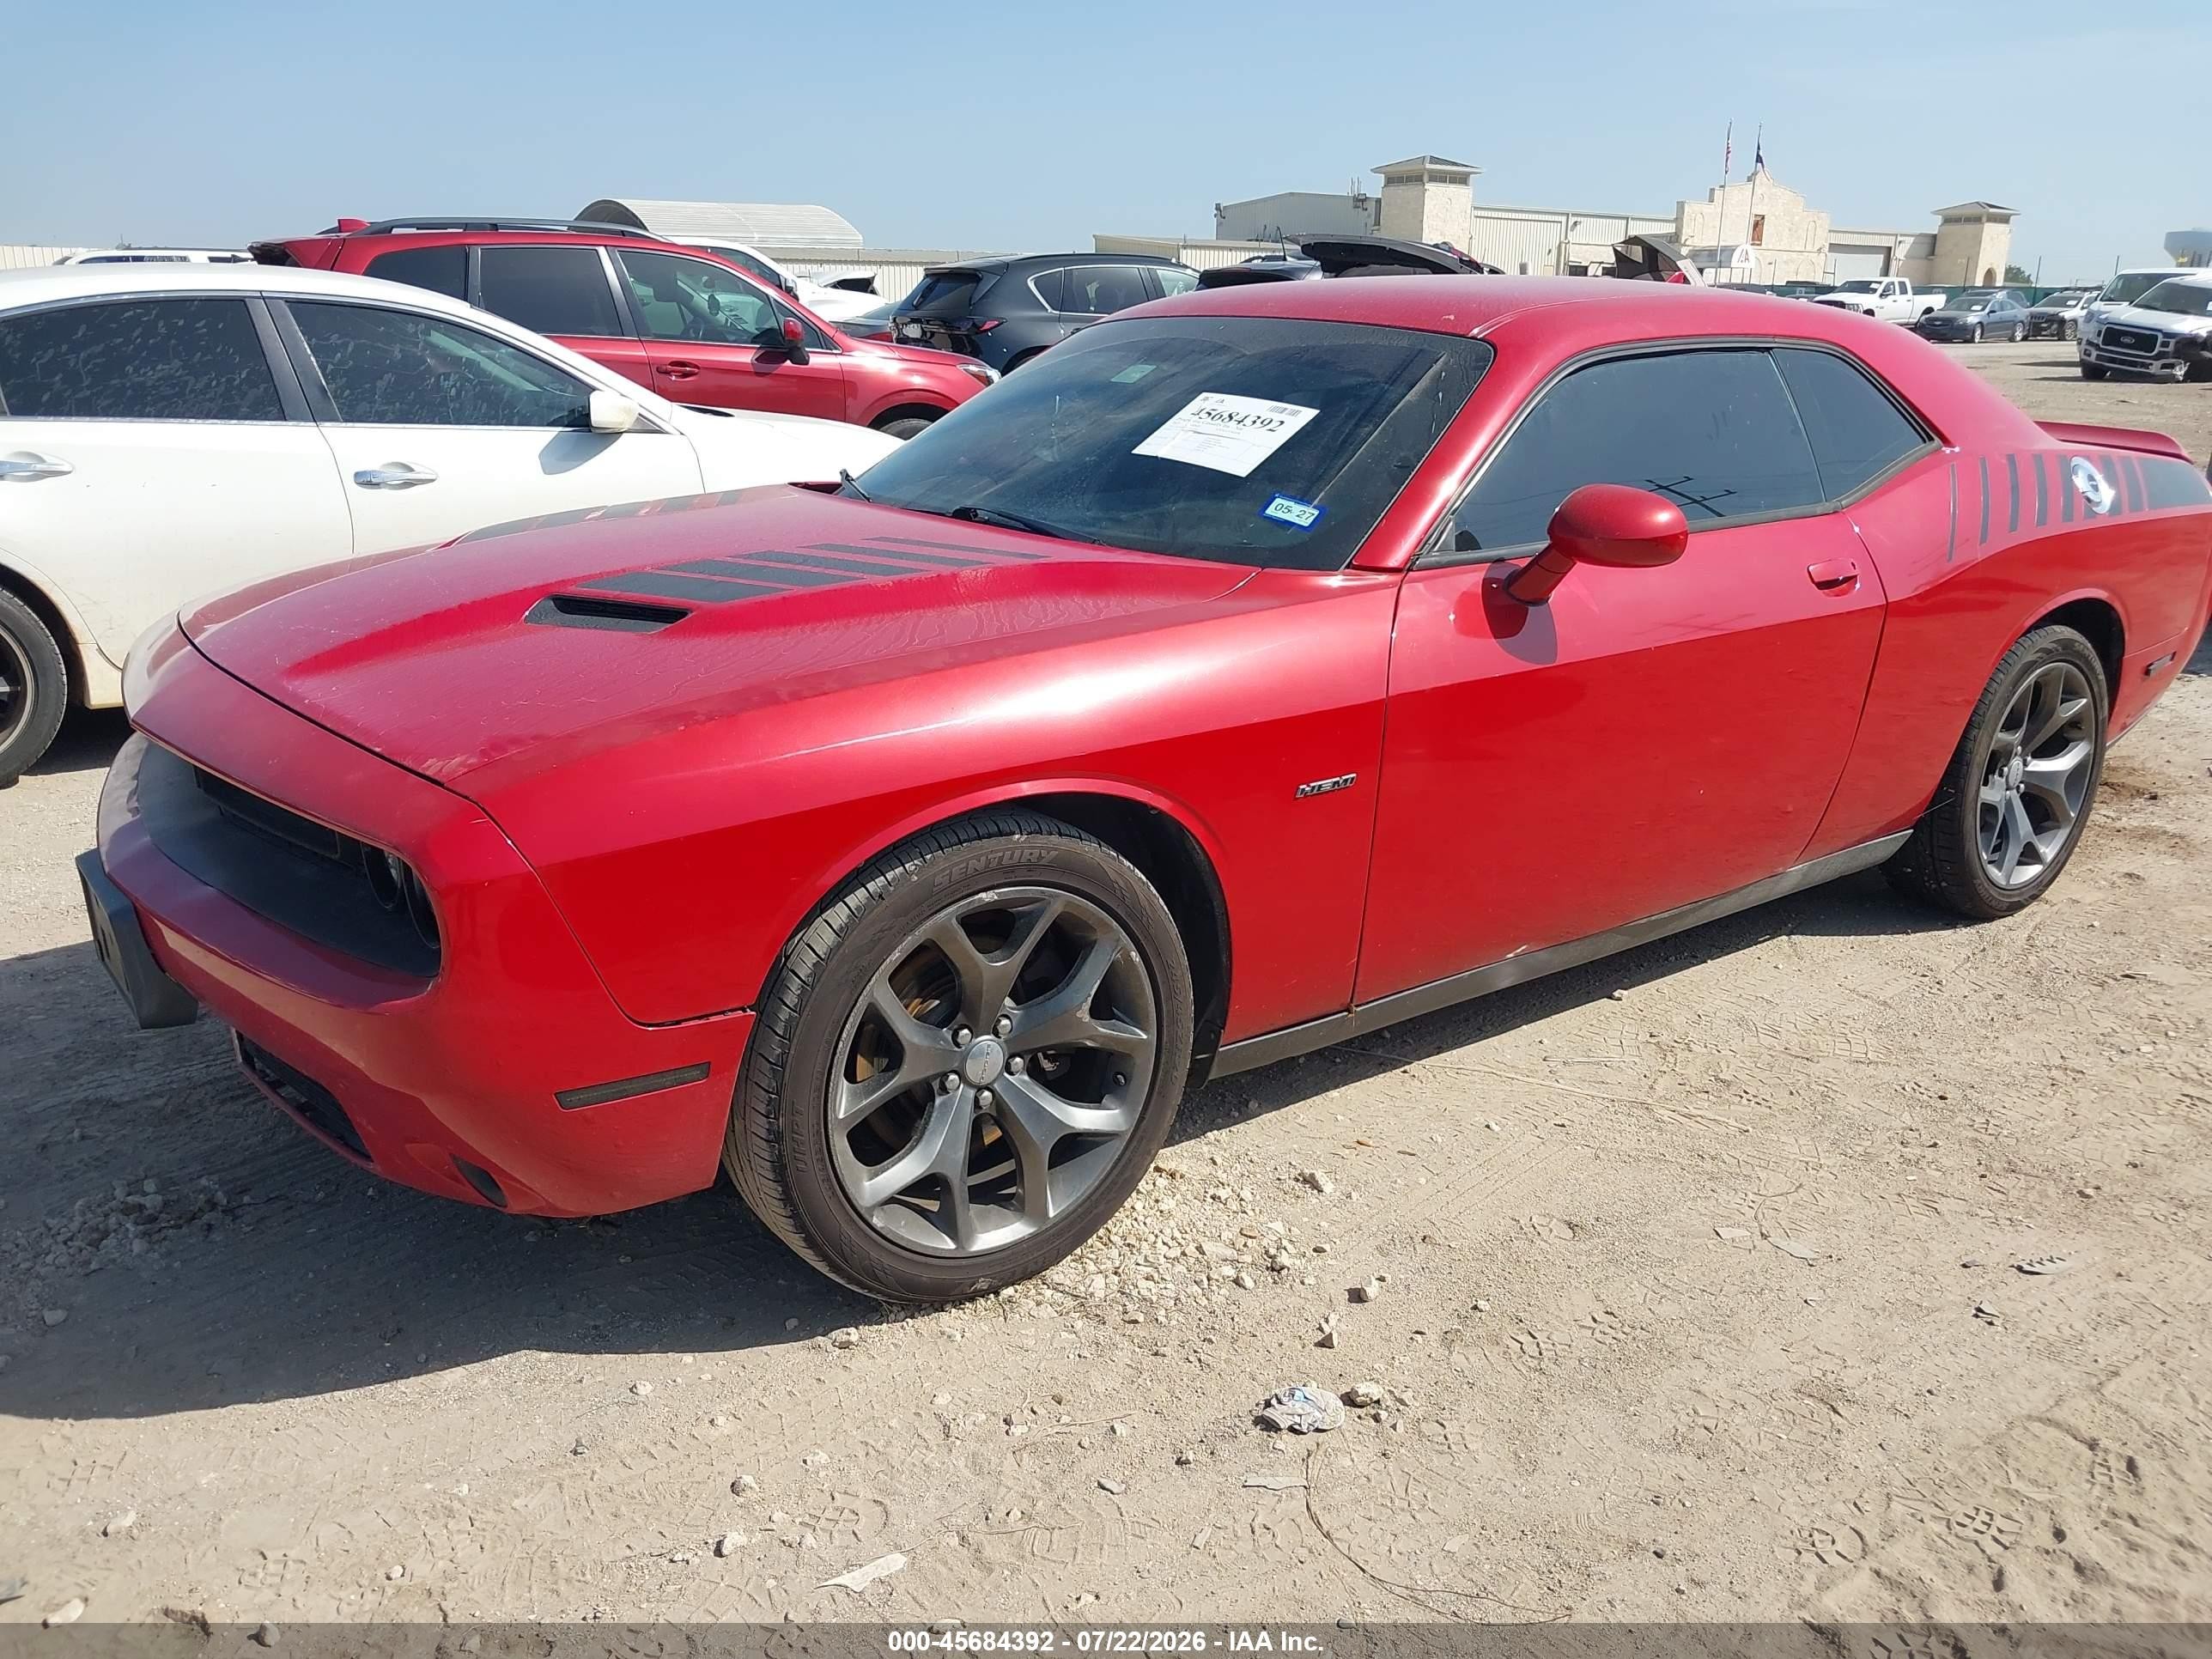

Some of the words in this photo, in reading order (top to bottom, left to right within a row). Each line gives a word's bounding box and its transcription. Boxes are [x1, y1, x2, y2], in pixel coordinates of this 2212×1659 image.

[1190, 404, 1285, 432] 45684392
[1295, 509, 1316, 521] 27
[1295, 773, 1358, 799] HEMI
[934, 848, 1059, 888] SENTURY
